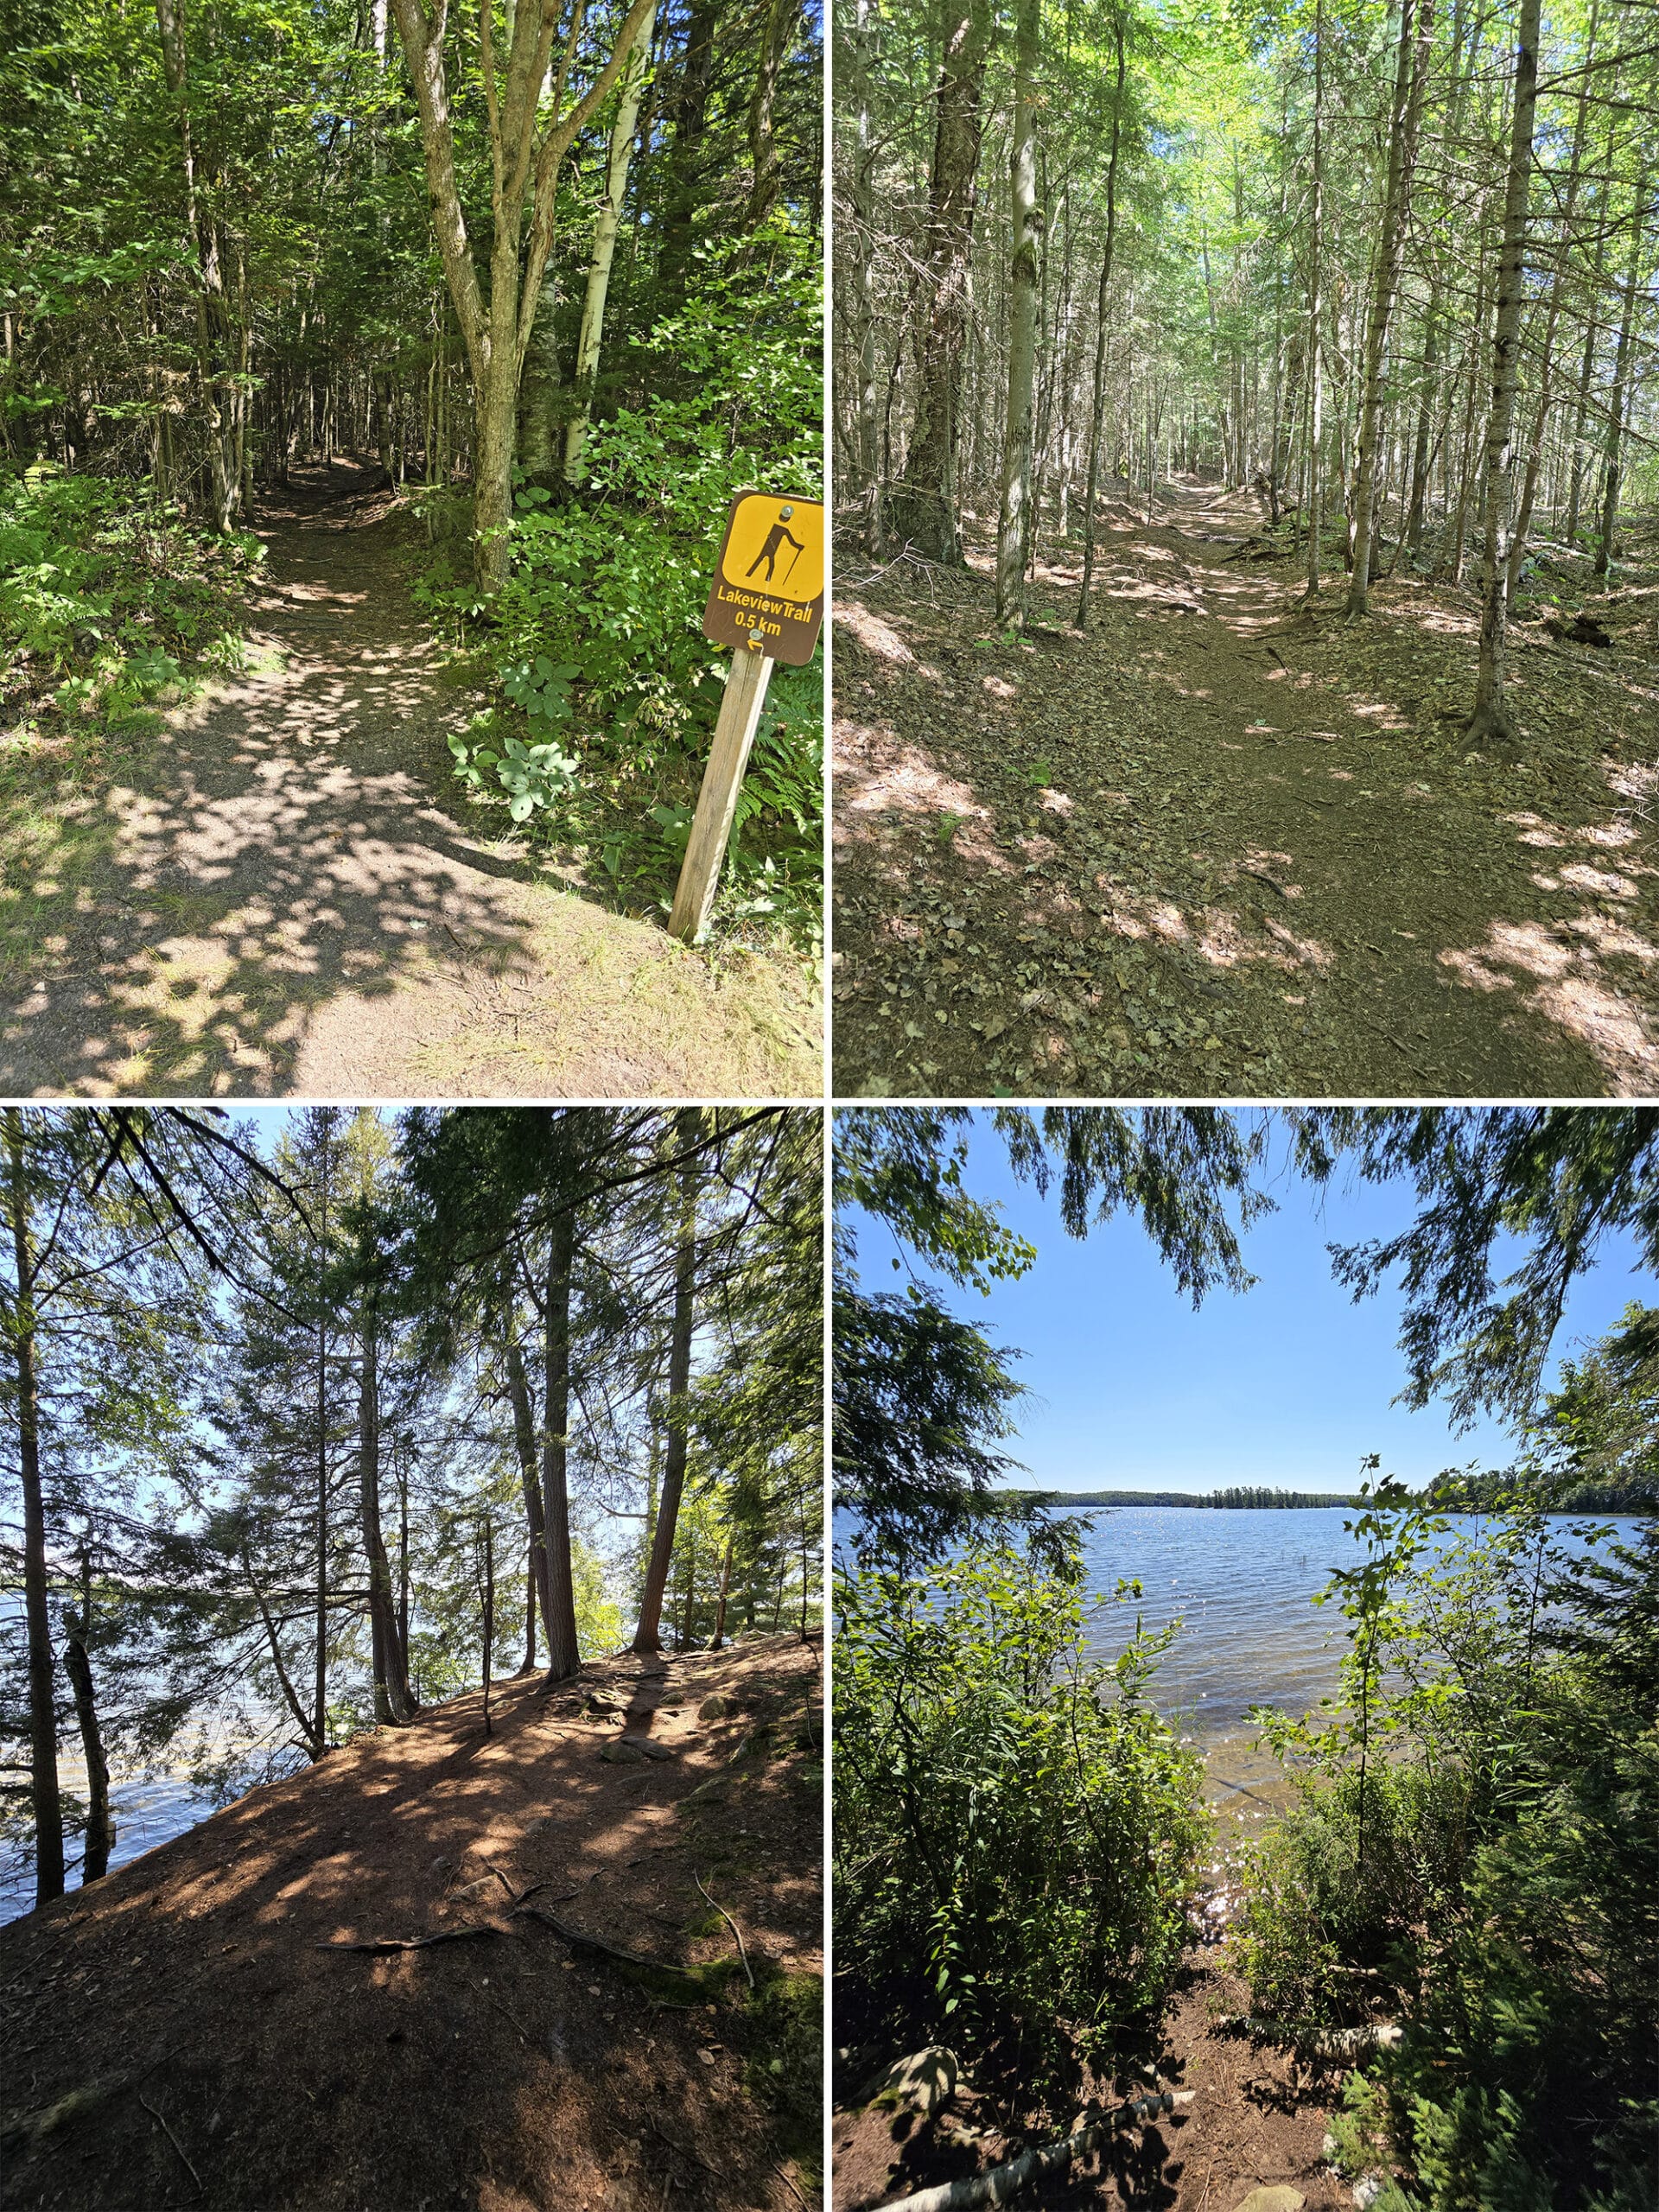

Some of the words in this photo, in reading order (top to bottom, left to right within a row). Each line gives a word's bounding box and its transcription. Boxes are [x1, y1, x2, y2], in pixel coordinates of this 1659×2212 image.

[717, 585, 783, 615] Lakeview
[783, 601, 813, 623] Trail
[734, 611, 757, 629] 0.5
[758, 617, 782, 637] km
